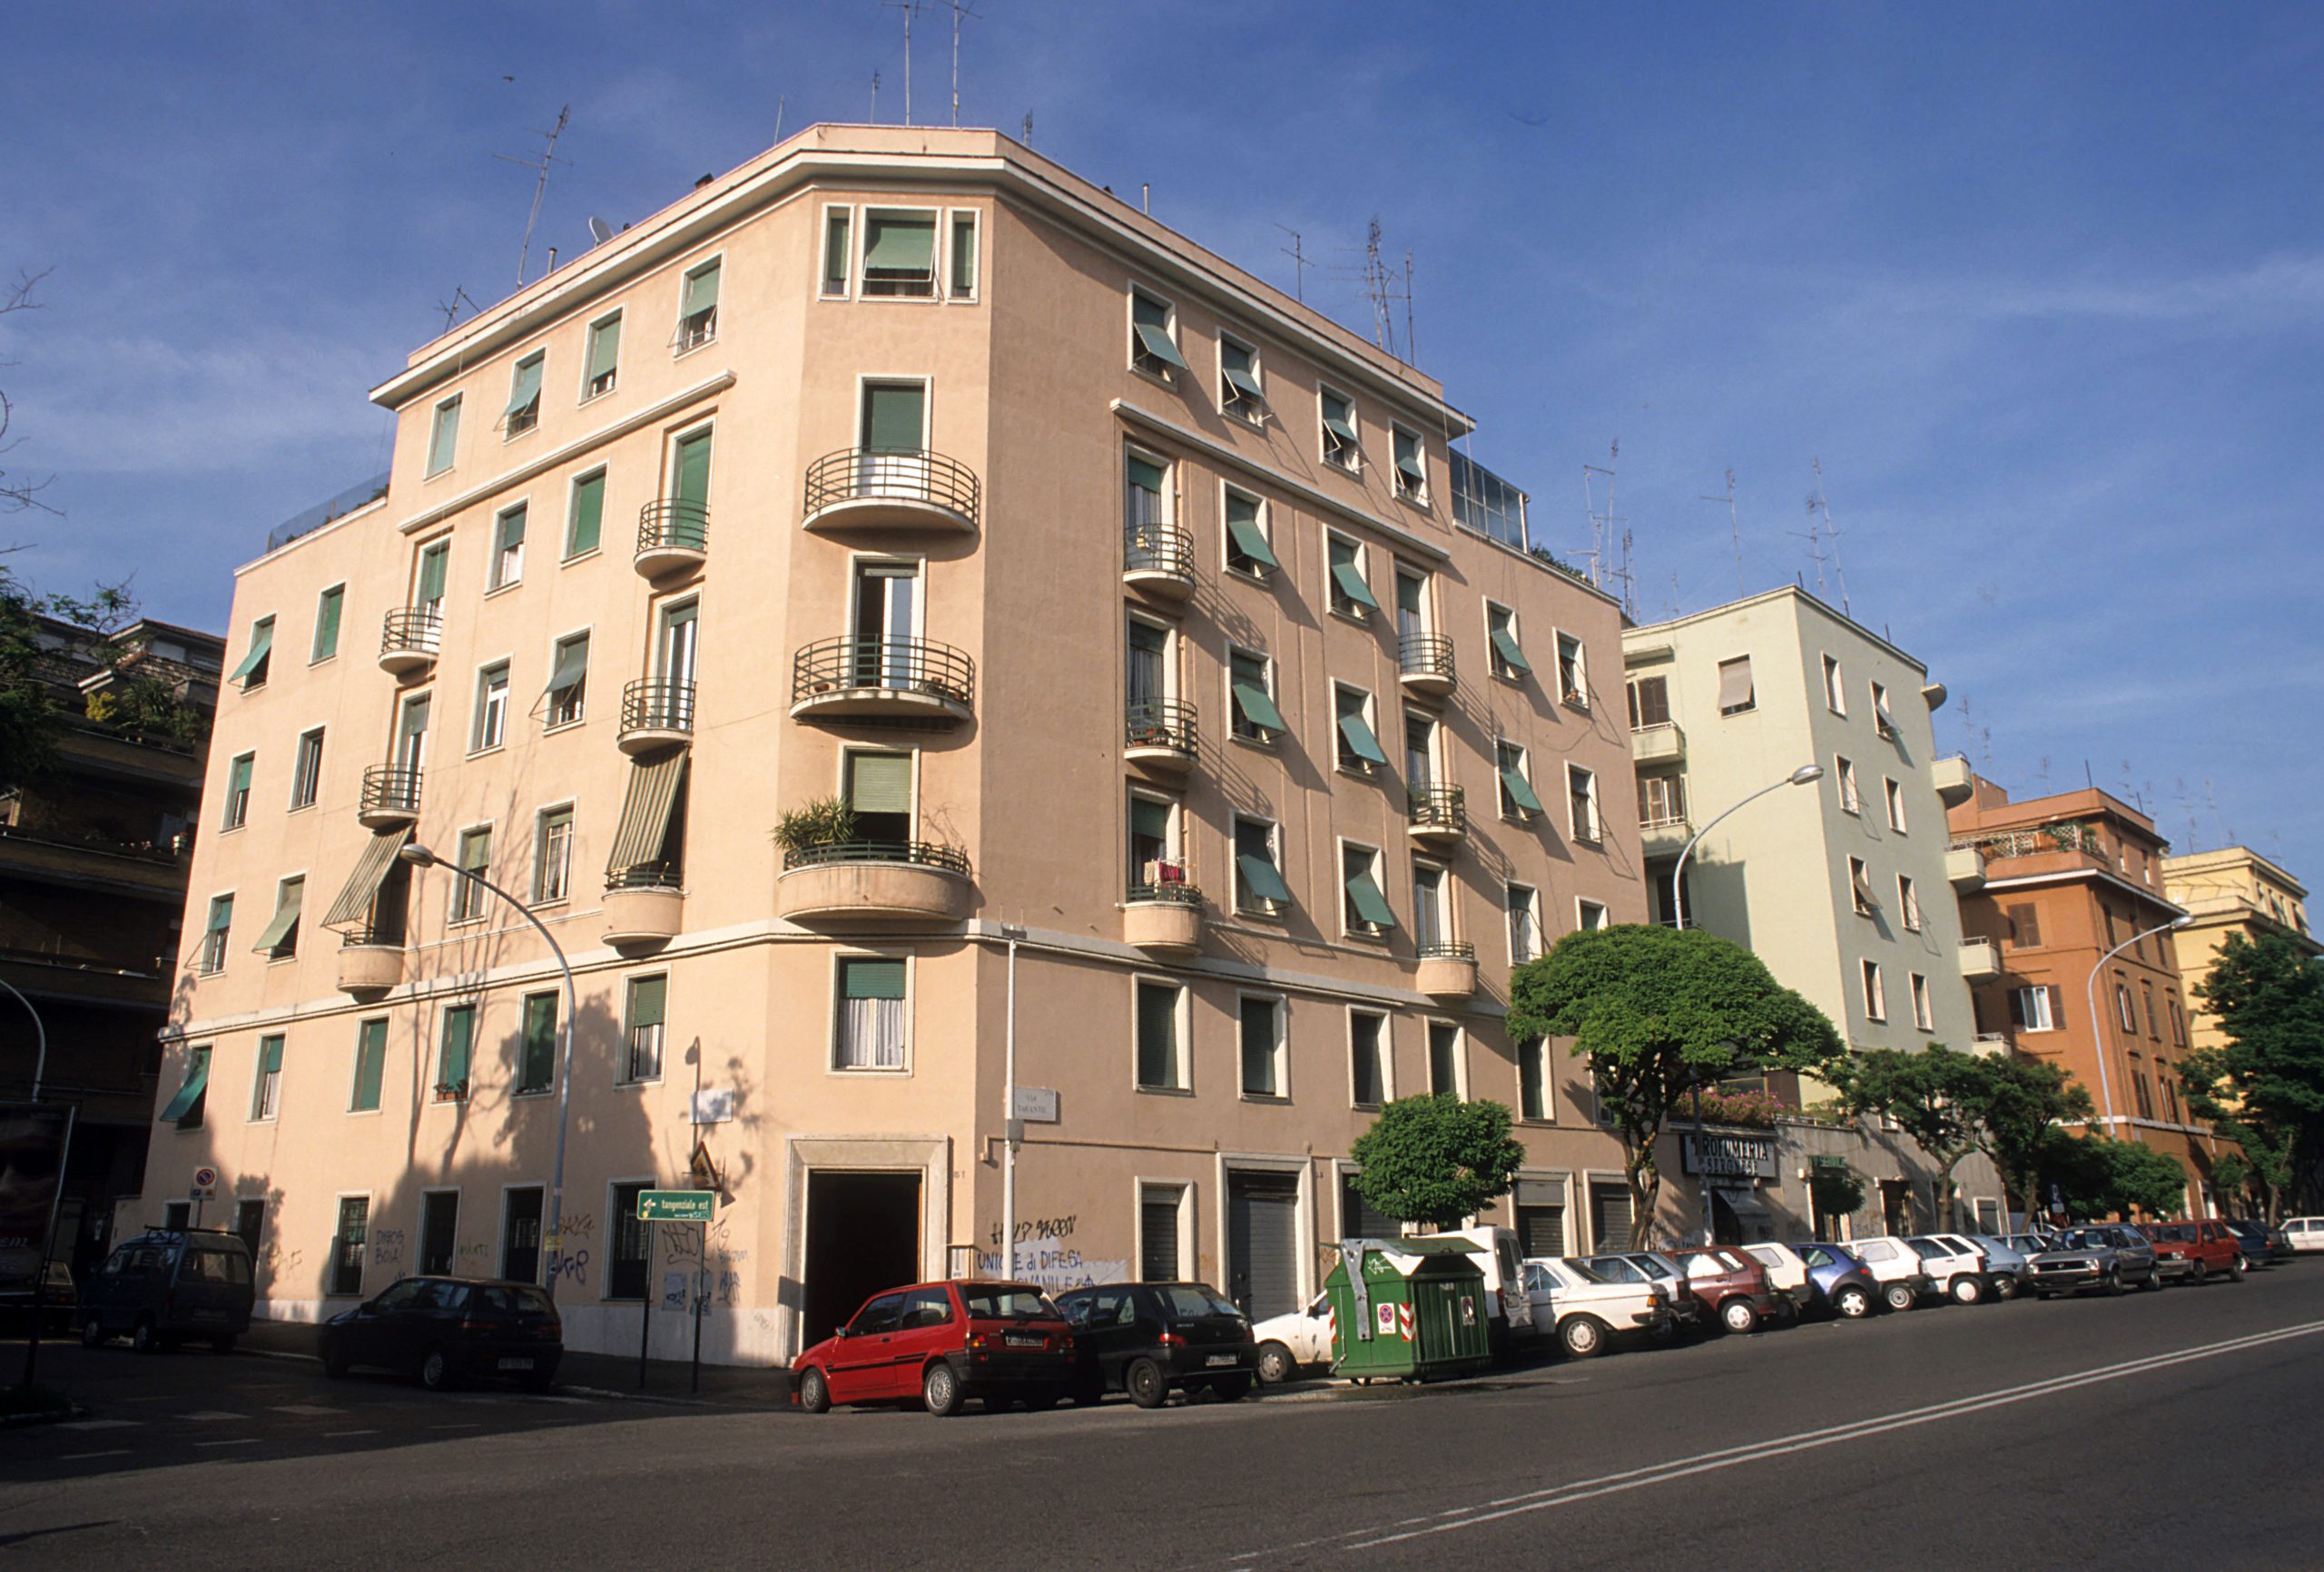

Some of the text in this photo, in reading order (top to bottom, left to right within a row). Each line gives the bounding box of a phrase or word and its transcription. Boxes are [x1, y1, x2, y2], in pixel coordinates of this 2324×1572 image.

[662, 1199, 708, 1212] tangenziale est
[1041, 1250, 1082, 1270] DIFESA
